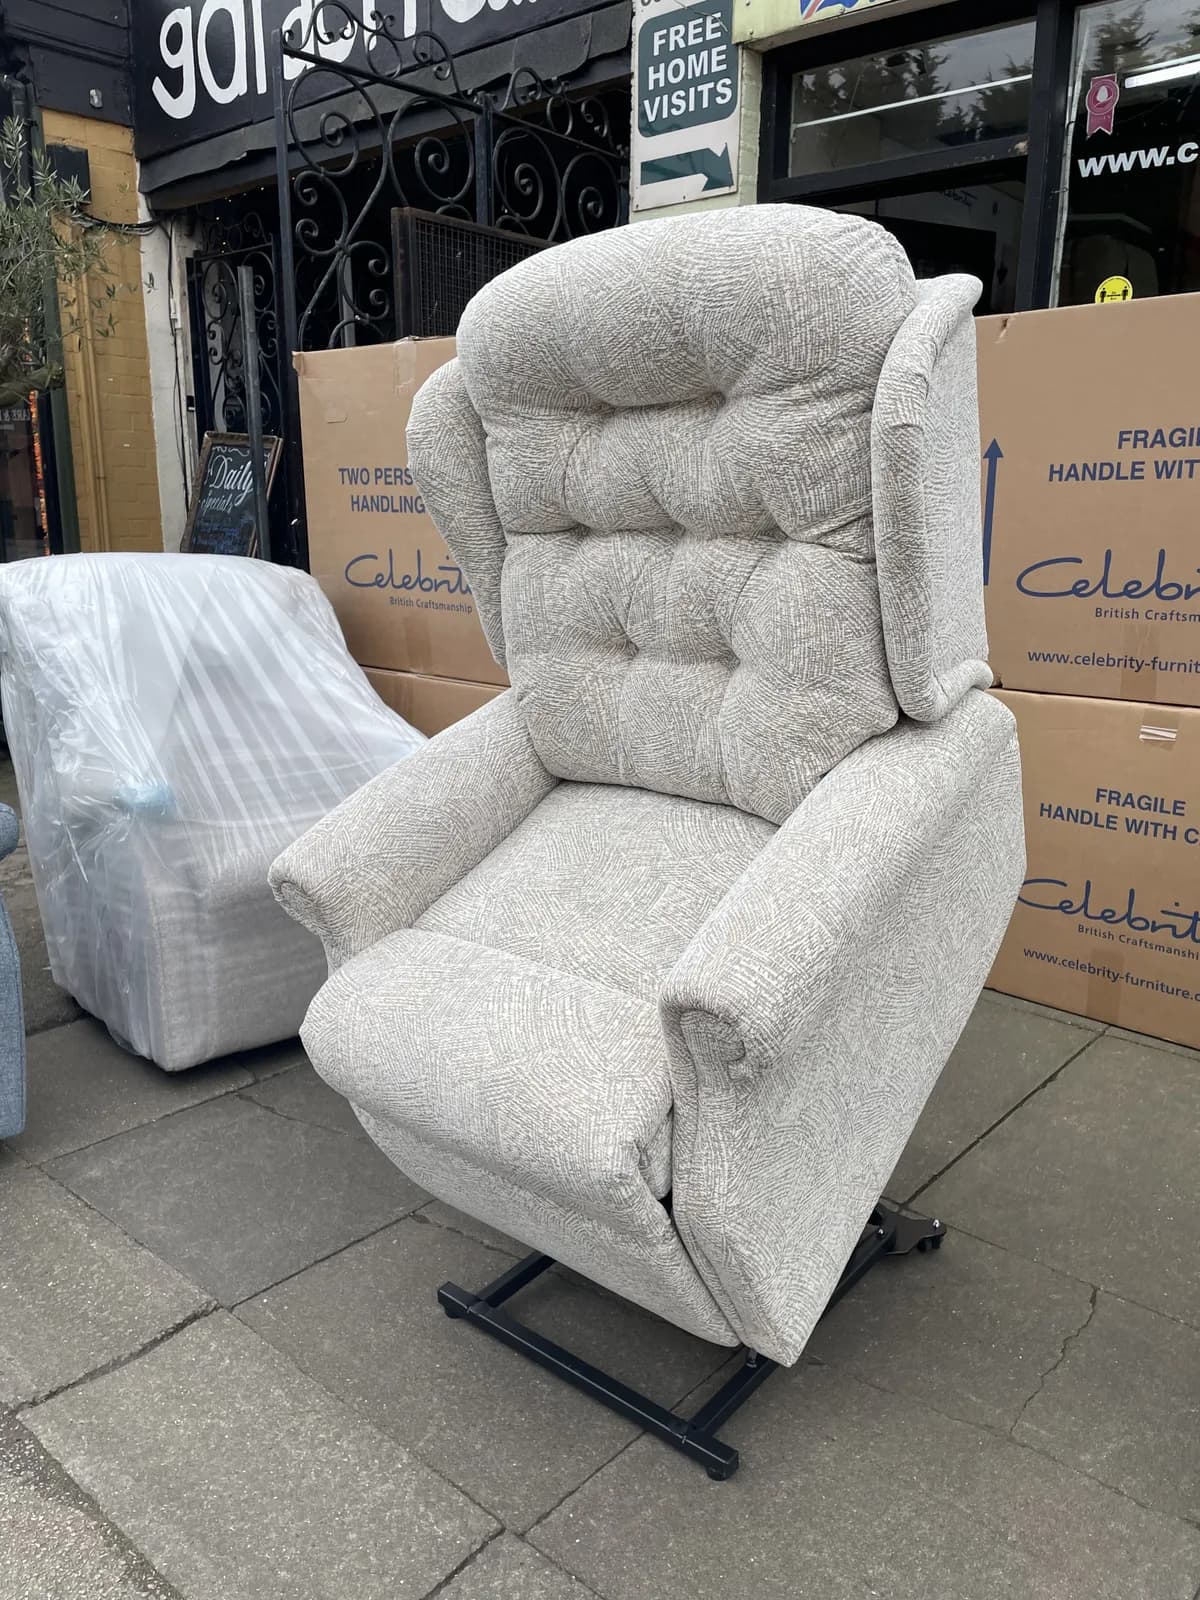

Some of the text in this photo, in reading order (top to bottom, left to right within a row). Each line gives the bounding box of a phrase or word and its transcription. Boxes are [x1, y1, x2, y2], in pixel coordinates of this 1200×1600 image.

[653, 12, 722, 56] FREE
[648, 45, 727, 91] HOME
[643, 78, 732, 123] VISITS
[1078, 141, 1200, 178] www.c
[1117, 427, 1200, 450] FRAGI
[208, 454, 254, 507] Daily
[338, 467, 370, 485] TWO
[1049, 459, 1200, 482] HANDLE WIT
[351, 495, 426, 514] HANDLING
[344, 548, 472, 595] Celebrit
[389, 596, 473, 614] British Craftsmanship
[1095, 607, 1140, 620] British
[1096, 787, 1186, 817] FRAGILE
[1040, 802, 1200, 845] HANDLE WITH C
[1078, 923, 1200, 961] British Craftsmanshi
